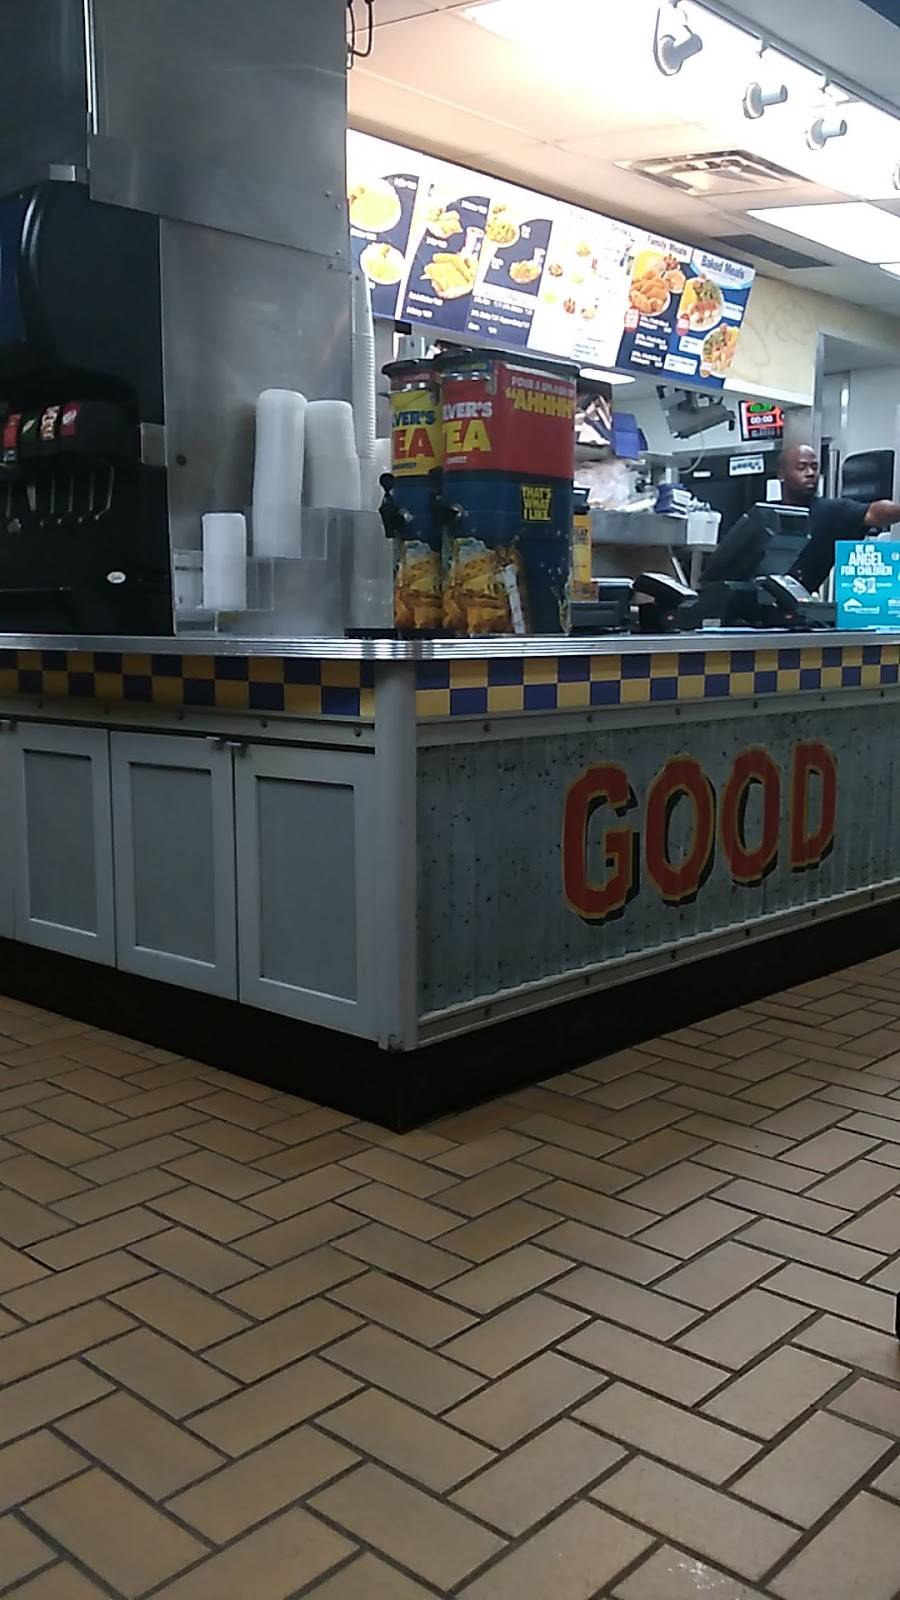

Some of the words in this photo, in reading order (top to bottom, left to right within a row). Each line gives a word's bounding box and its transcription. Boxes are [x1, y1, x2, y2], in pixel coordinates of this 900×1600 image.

[701, 255, 724, 272] Baked
[725, 262, 745, 280] Meals
[848, 552, 885, 566] ANGEL
[840, 565, 856, 576] FOR
[857, 565, 893, 576] CHILDREN
[852, 577, 877, 595] $1
[563, 740, 837, 926] GOOD
